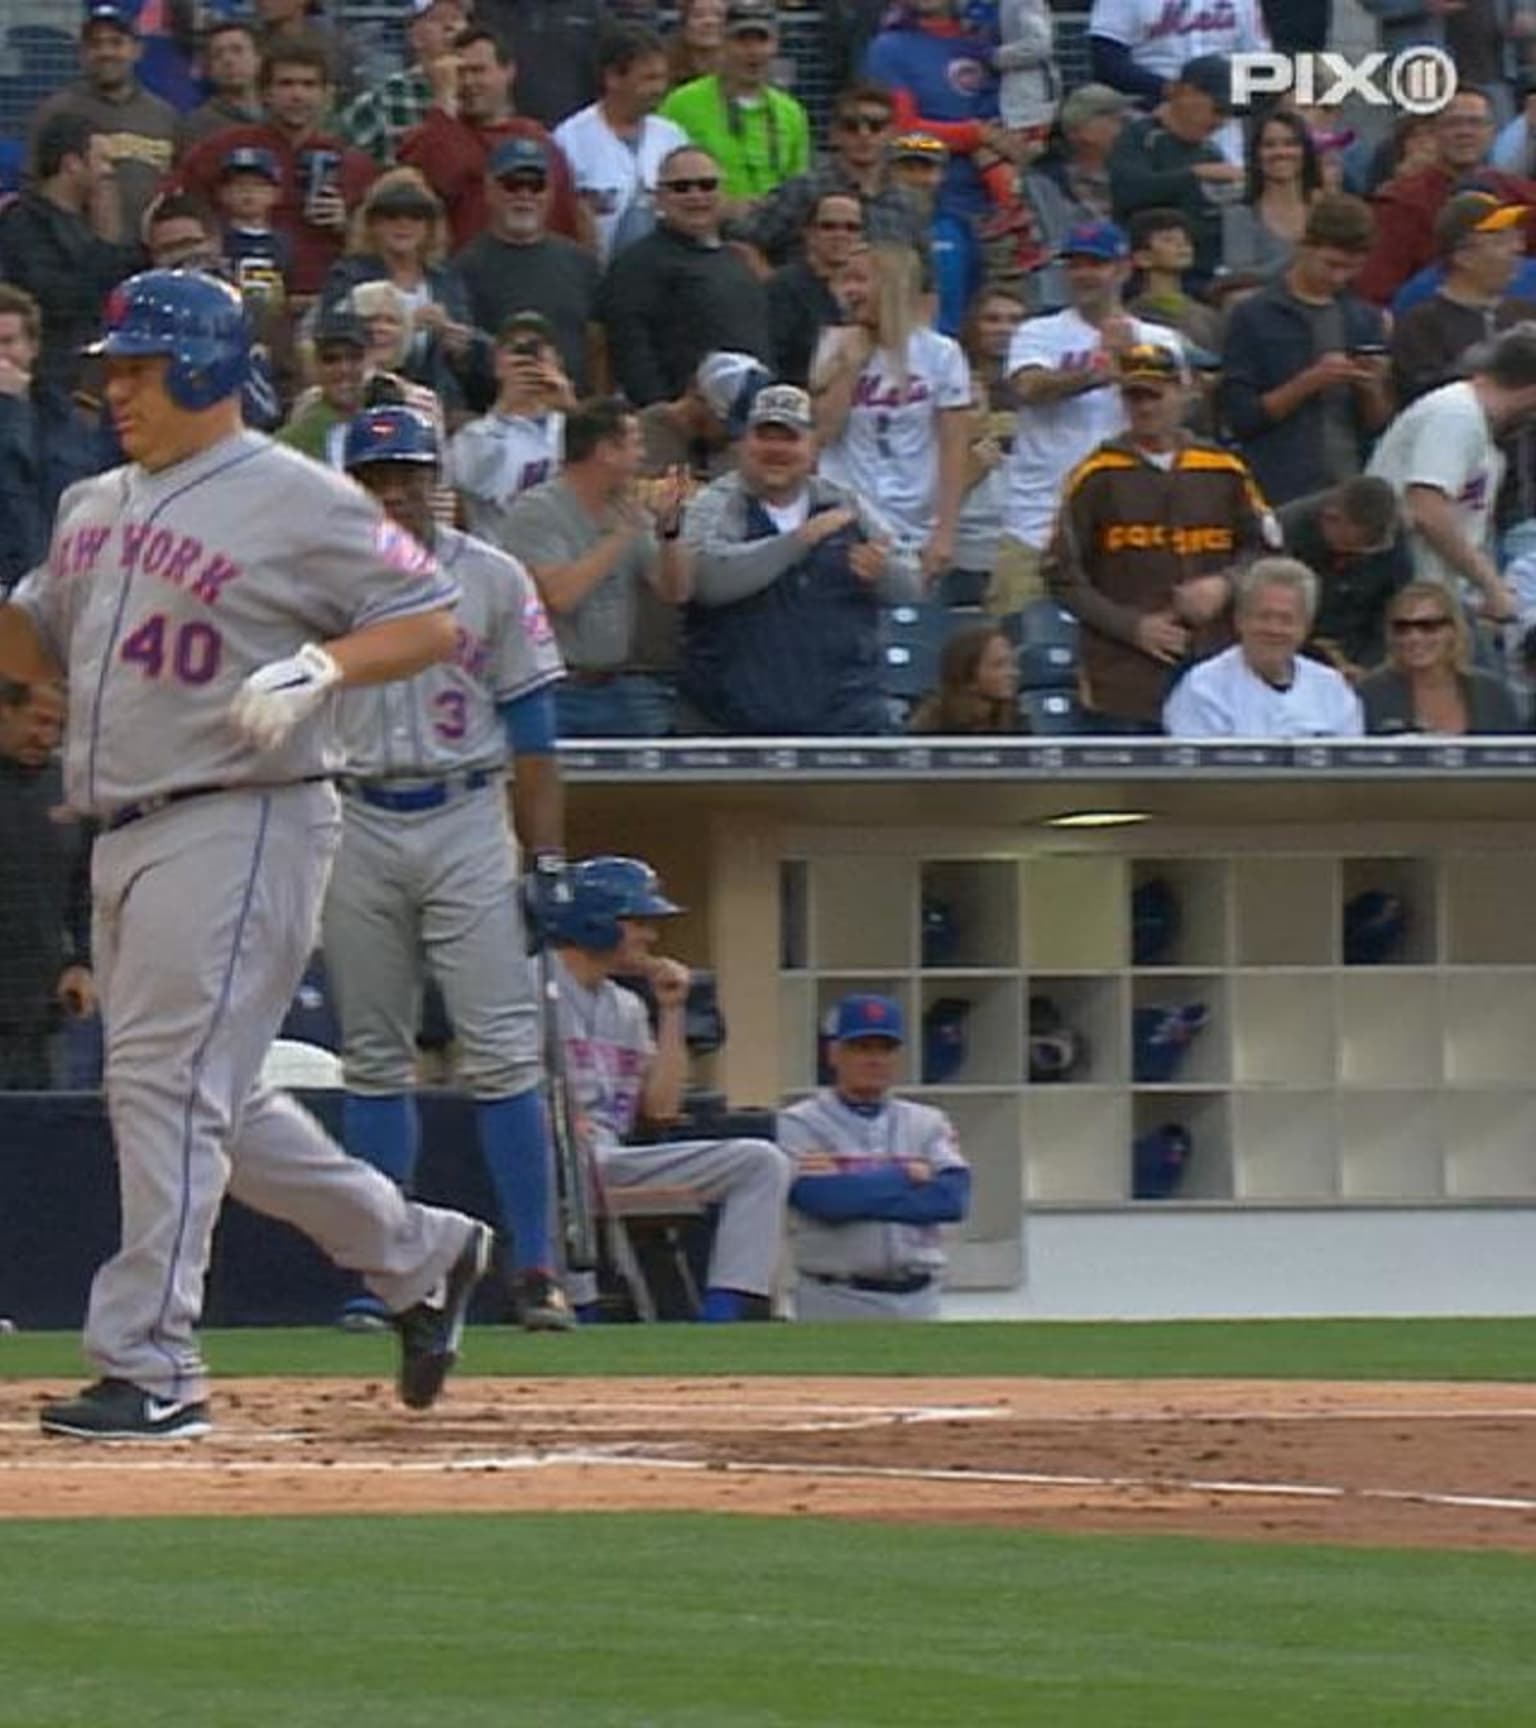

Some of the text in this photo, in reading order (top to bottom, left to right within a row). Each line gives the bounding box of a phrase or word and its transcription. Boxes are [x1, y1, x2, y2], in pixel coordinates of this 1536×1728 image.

[119, 522, 243, 605] YORK
[121, 611, 225, 687] 40
[430, 687, 468, 739] 3
